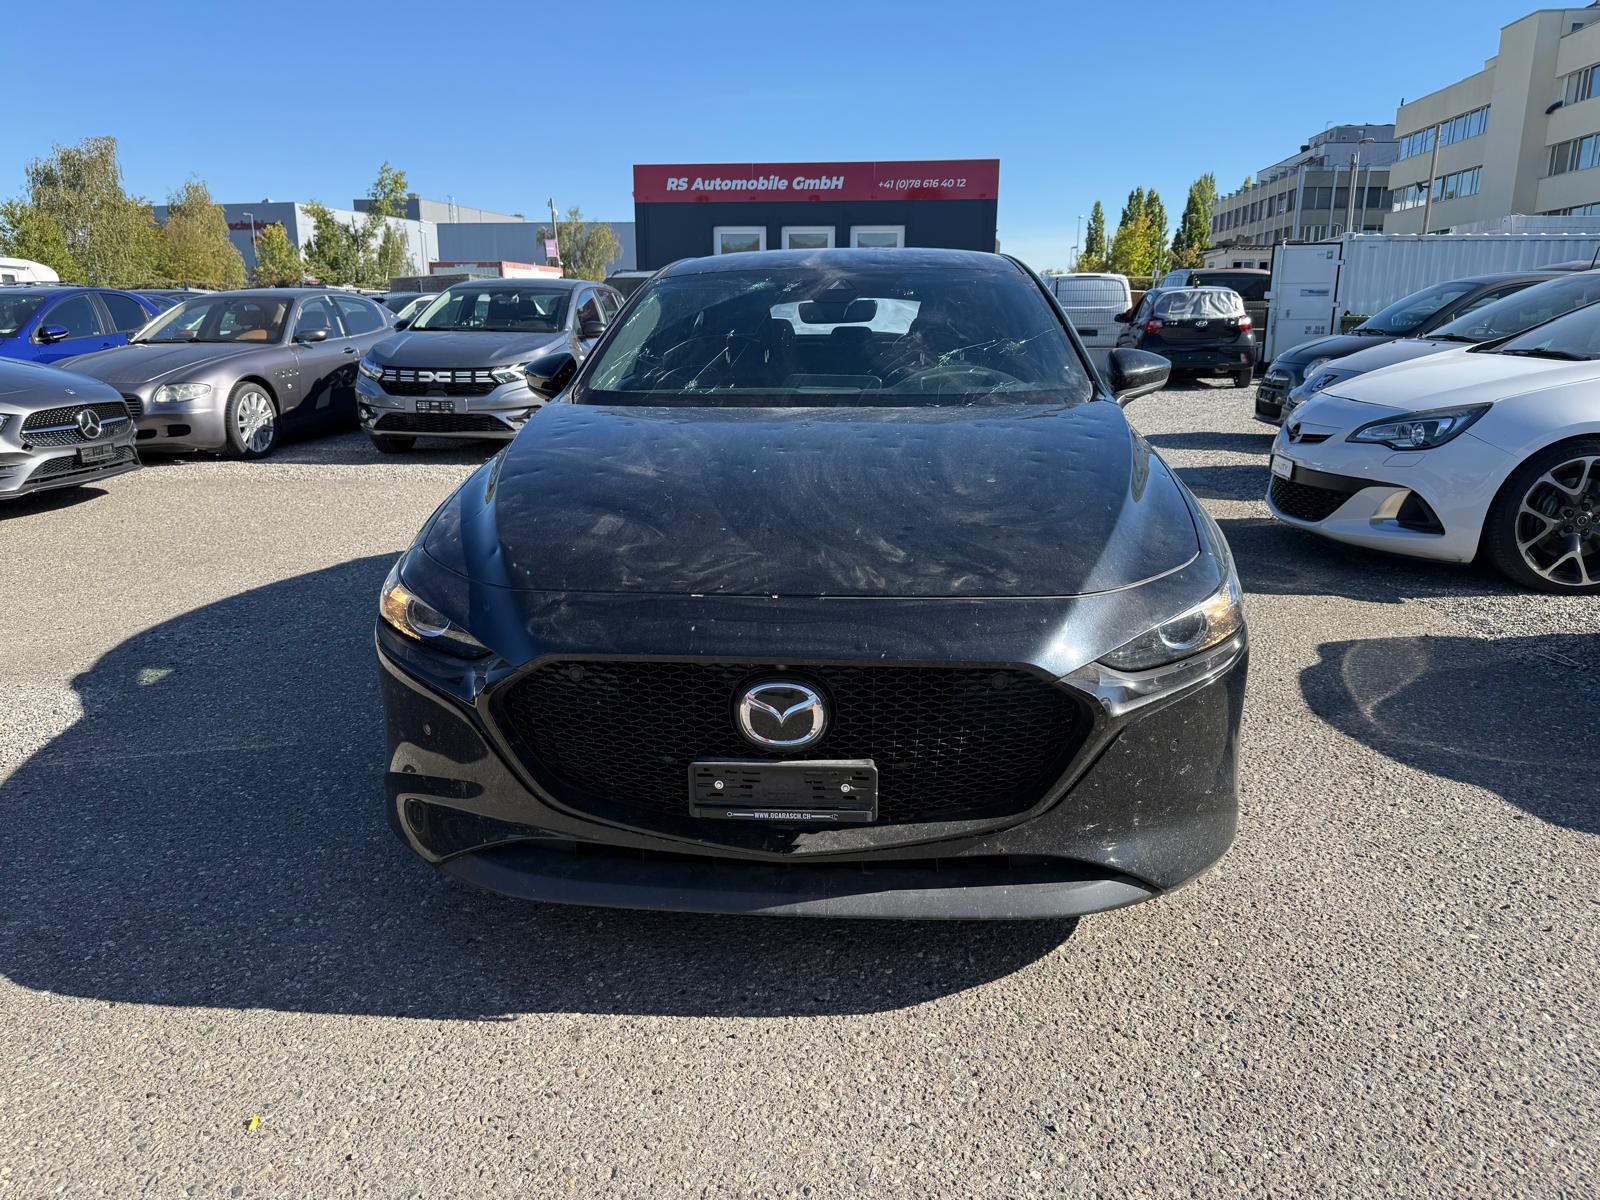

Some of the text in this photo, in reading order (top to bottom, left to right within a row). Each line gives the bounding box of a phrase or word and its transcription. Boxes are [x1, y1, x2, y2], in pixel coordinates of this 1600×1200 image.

[666, 175, 845, 191] RS Automobile GmbH
[878, 178, 967, 190] +41 (0)78 616 40 12
